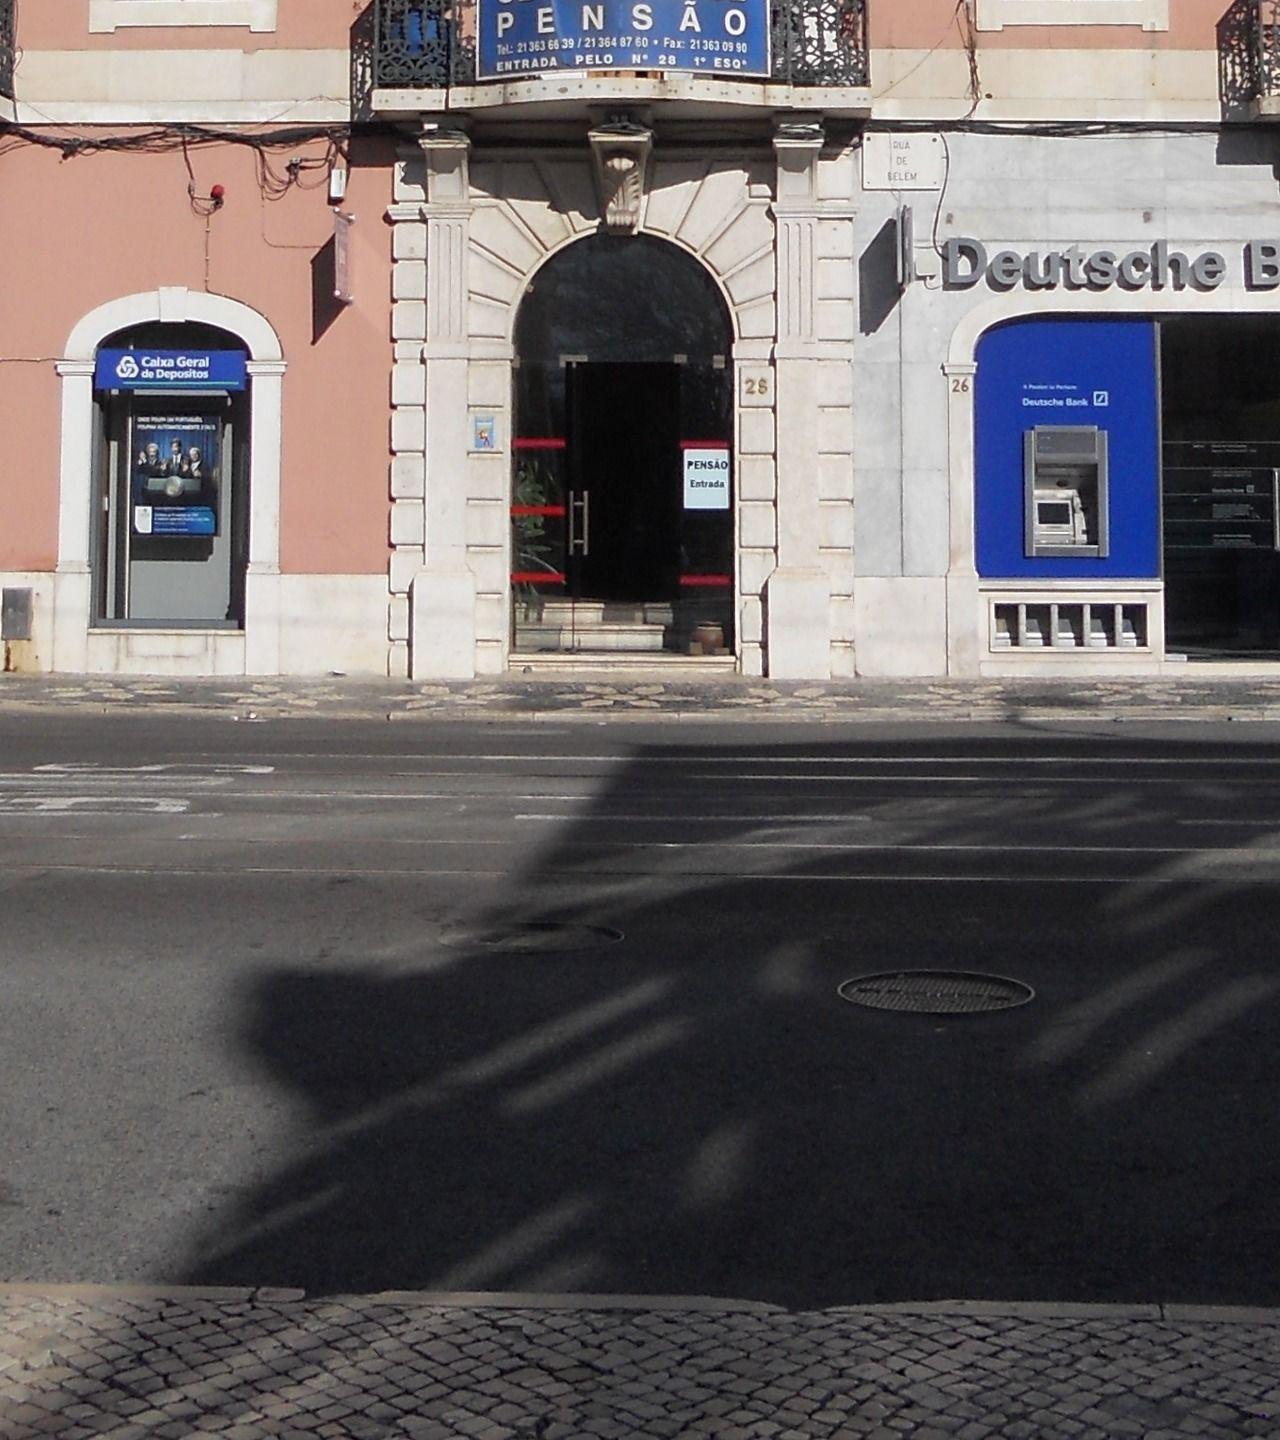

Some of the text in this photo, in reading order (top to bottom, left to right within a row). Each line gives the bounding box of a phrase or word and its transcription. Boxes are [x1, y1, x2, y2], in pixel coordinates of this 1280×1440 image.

[497, 0, 748, 38] PENSÃO
[496, 56, 558, 72] ENTRADA
[575, 54, 613, 66] PELO
[658, 54, 677, 66] 28
[892, 140, 911, 150] RUA
[895, 155, 909, 166] DE
[942, 236, 1228, 293] Deutsche
[141, 356, 210, 368] Caixa Geral
[141, 368, 155, 379] de
[744, 378, 769, 395] 28
[951, 378, 969, 393] 26
[1022, 397, 1089, 407] Deutsche Bank
[687, 458, 729, 470] PENSÃO
[689, 479, 725, 488] Entrada
